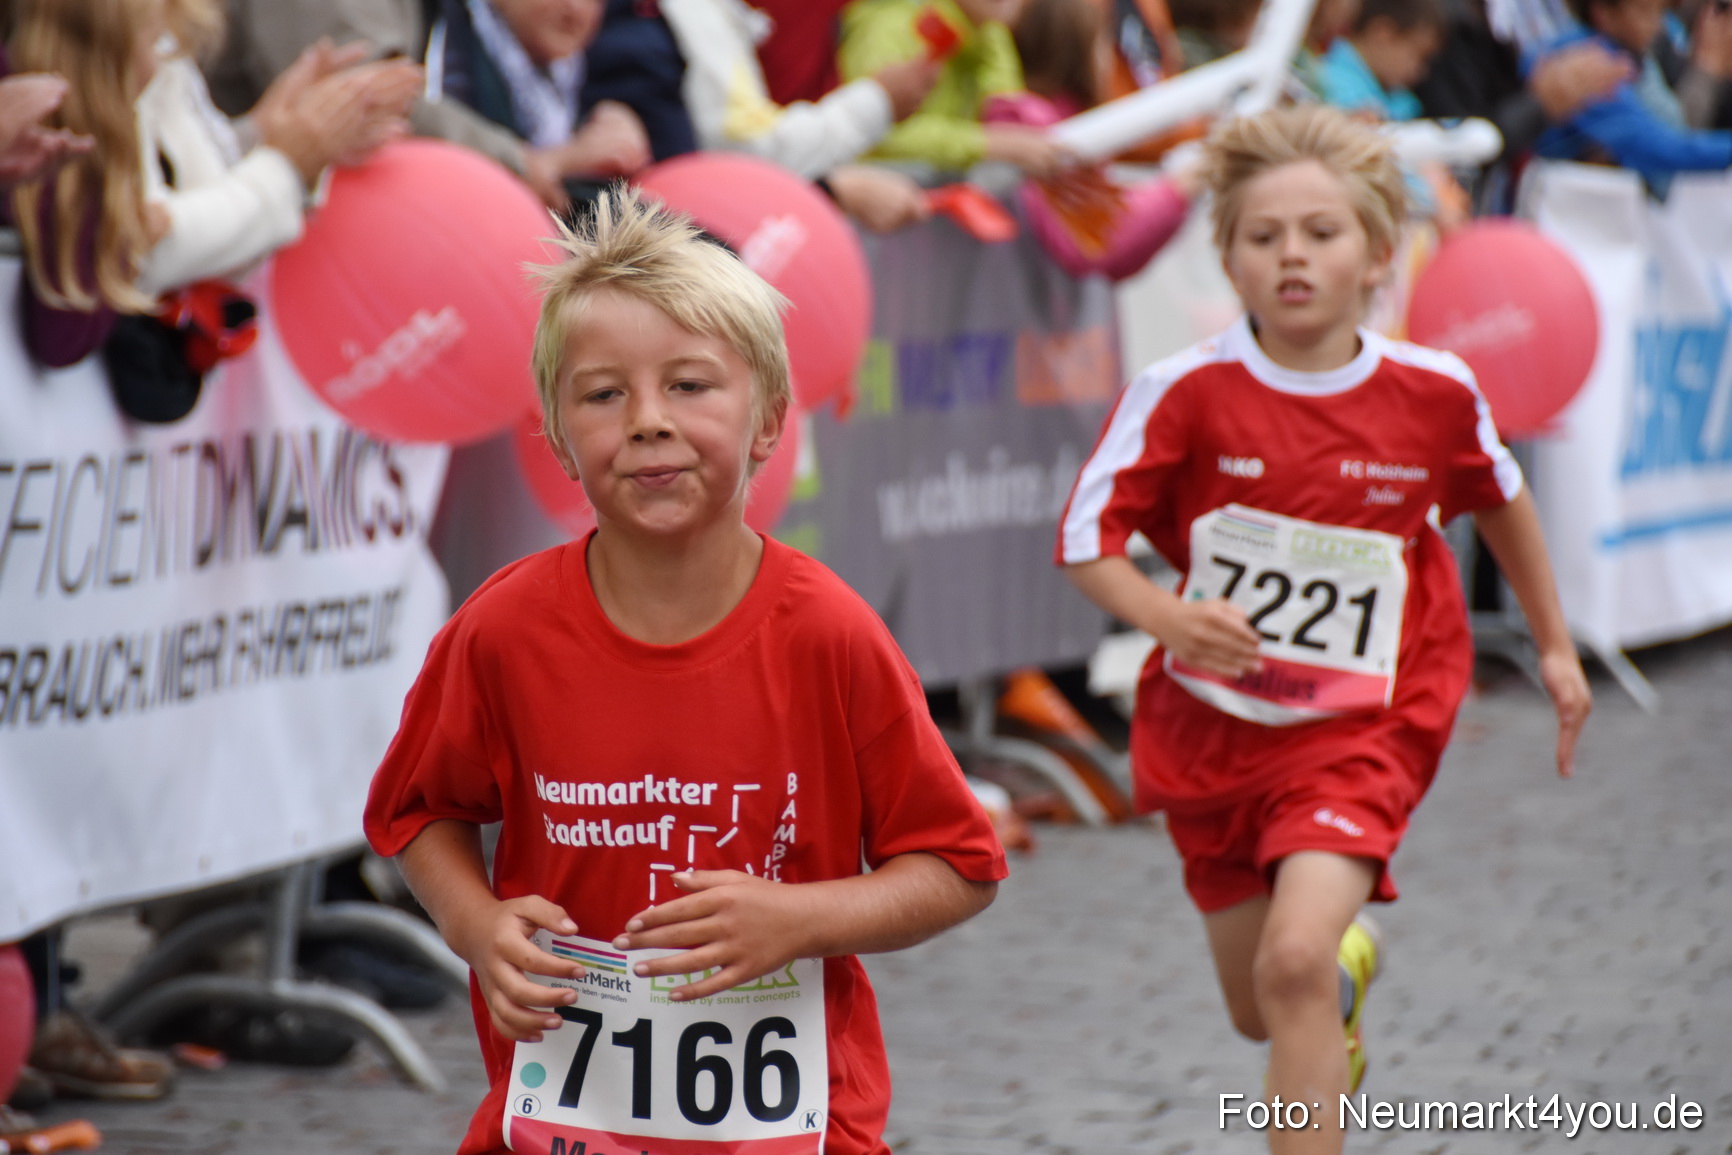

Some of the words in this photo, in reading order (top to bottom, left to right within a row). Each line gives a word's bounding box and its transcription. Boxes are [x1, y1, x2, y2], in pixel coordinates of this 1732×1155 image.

[1211, 554, 1378, 658] 7221
[534, 772, 718, 806] Neumarkter
[543, 812, 676, 851] Stadtlauf
[699, 996, 714, 1007] by
[716, 995, 750, 1005] smart
[753, 989, 801, 1003] concepts
[554, 1005, 801, 1126] 7166
[521, 1097, 533, 1114] 6
[805, 1111, 817, 1129] K
